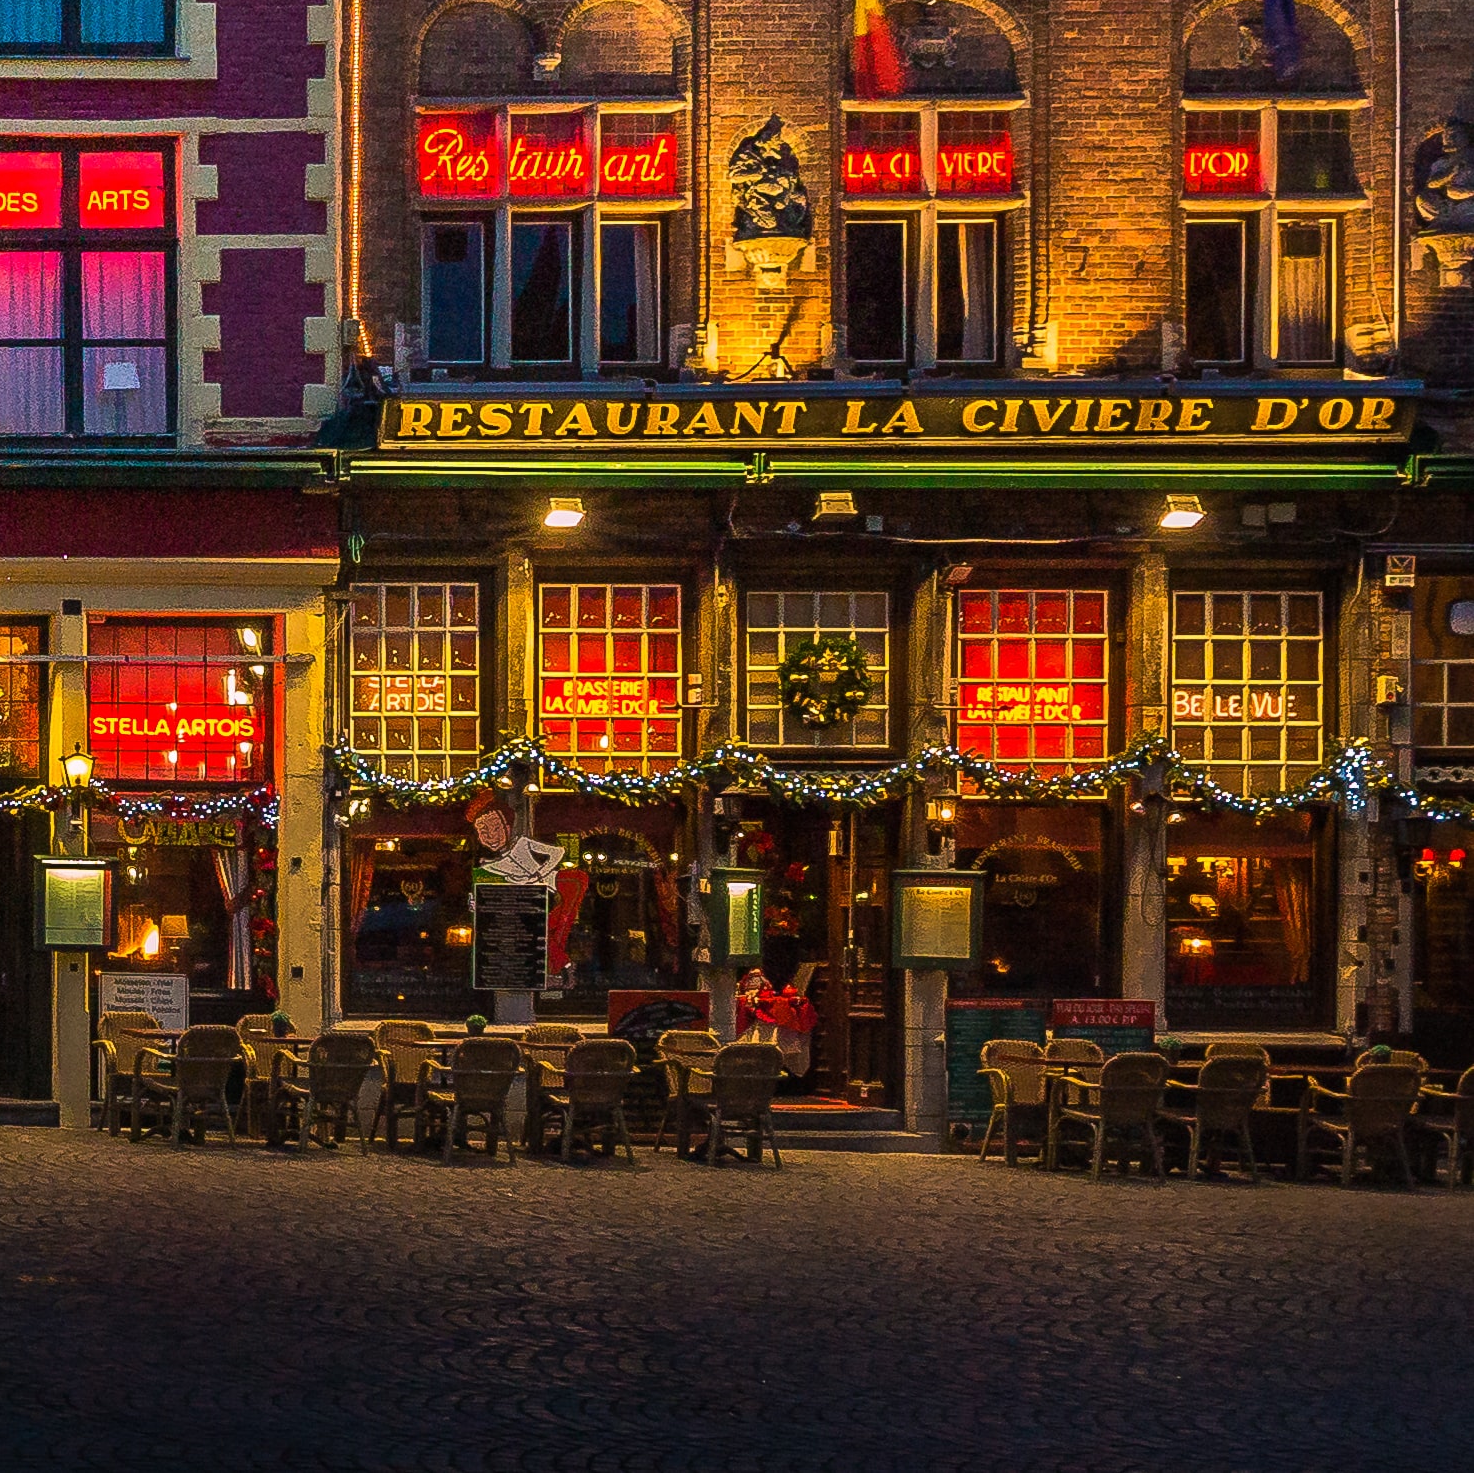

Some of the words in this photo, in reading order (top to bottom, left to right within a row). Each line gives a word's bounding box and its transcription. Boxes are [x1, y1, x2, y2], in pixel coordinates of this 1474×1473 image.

[847, 152, 876, 179] LA
[1190, 151, 1250, 178] D'OR
[86, 189, 151, 211] ARTS
[397, 399, 808, 437] RESTAURANT
[841, 399, 925, 435] LA
[962, 398, 1214, 434] CIVIERE
[1250, 397, 1396, 433] D'OR
[563, 680, 642, 697] BRASSERIE
[976, 686, 1069, 703] RESTAUANT
[368, 692, 445, 711] ARTOIS
[545, 696, 564, 712] LA
[1174, 690, 1242, 717] BELE
[1251, 691, 1298, 717] VUE
[92, 716, 171, 736] STELLA
[176, 718, 255, 737] ARTOIS
